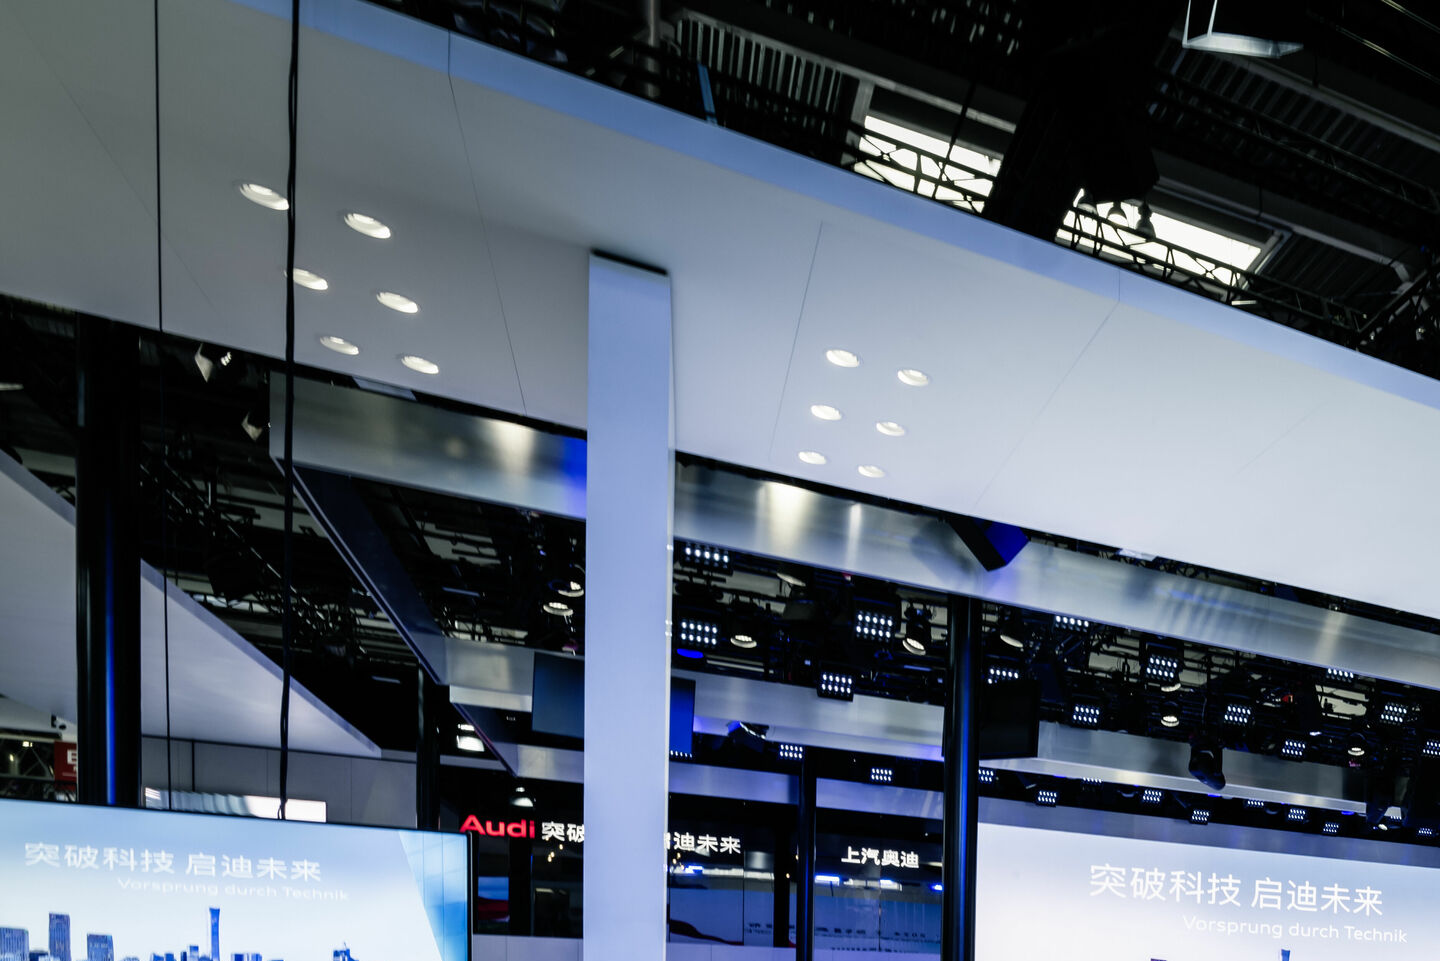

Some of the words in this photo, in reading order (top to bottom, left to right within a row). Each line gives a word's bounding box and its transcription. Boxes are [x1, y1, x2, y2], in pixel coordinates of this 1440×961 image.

[459, 814, 536, 839] Audi
[24, 842, 175, 875] 突破科技
[185, 852, 322, 882] 启迪未来
[841, 846, 920, 868] 上汽奥迪
[116, 876, 219, 897] Vorsprung
[224, 883, 278, 898] durch
[283, 885, 350, 902] Technik
[1089, 863, 1242, 907] 突破科技
[1250, 876, 1384, 917] 启迪未来
[1183, 914, 1283, 938] Vorsprung
[1288, 922, 1340, 939] durch
[1344, 924, 1408, 944] Technik
